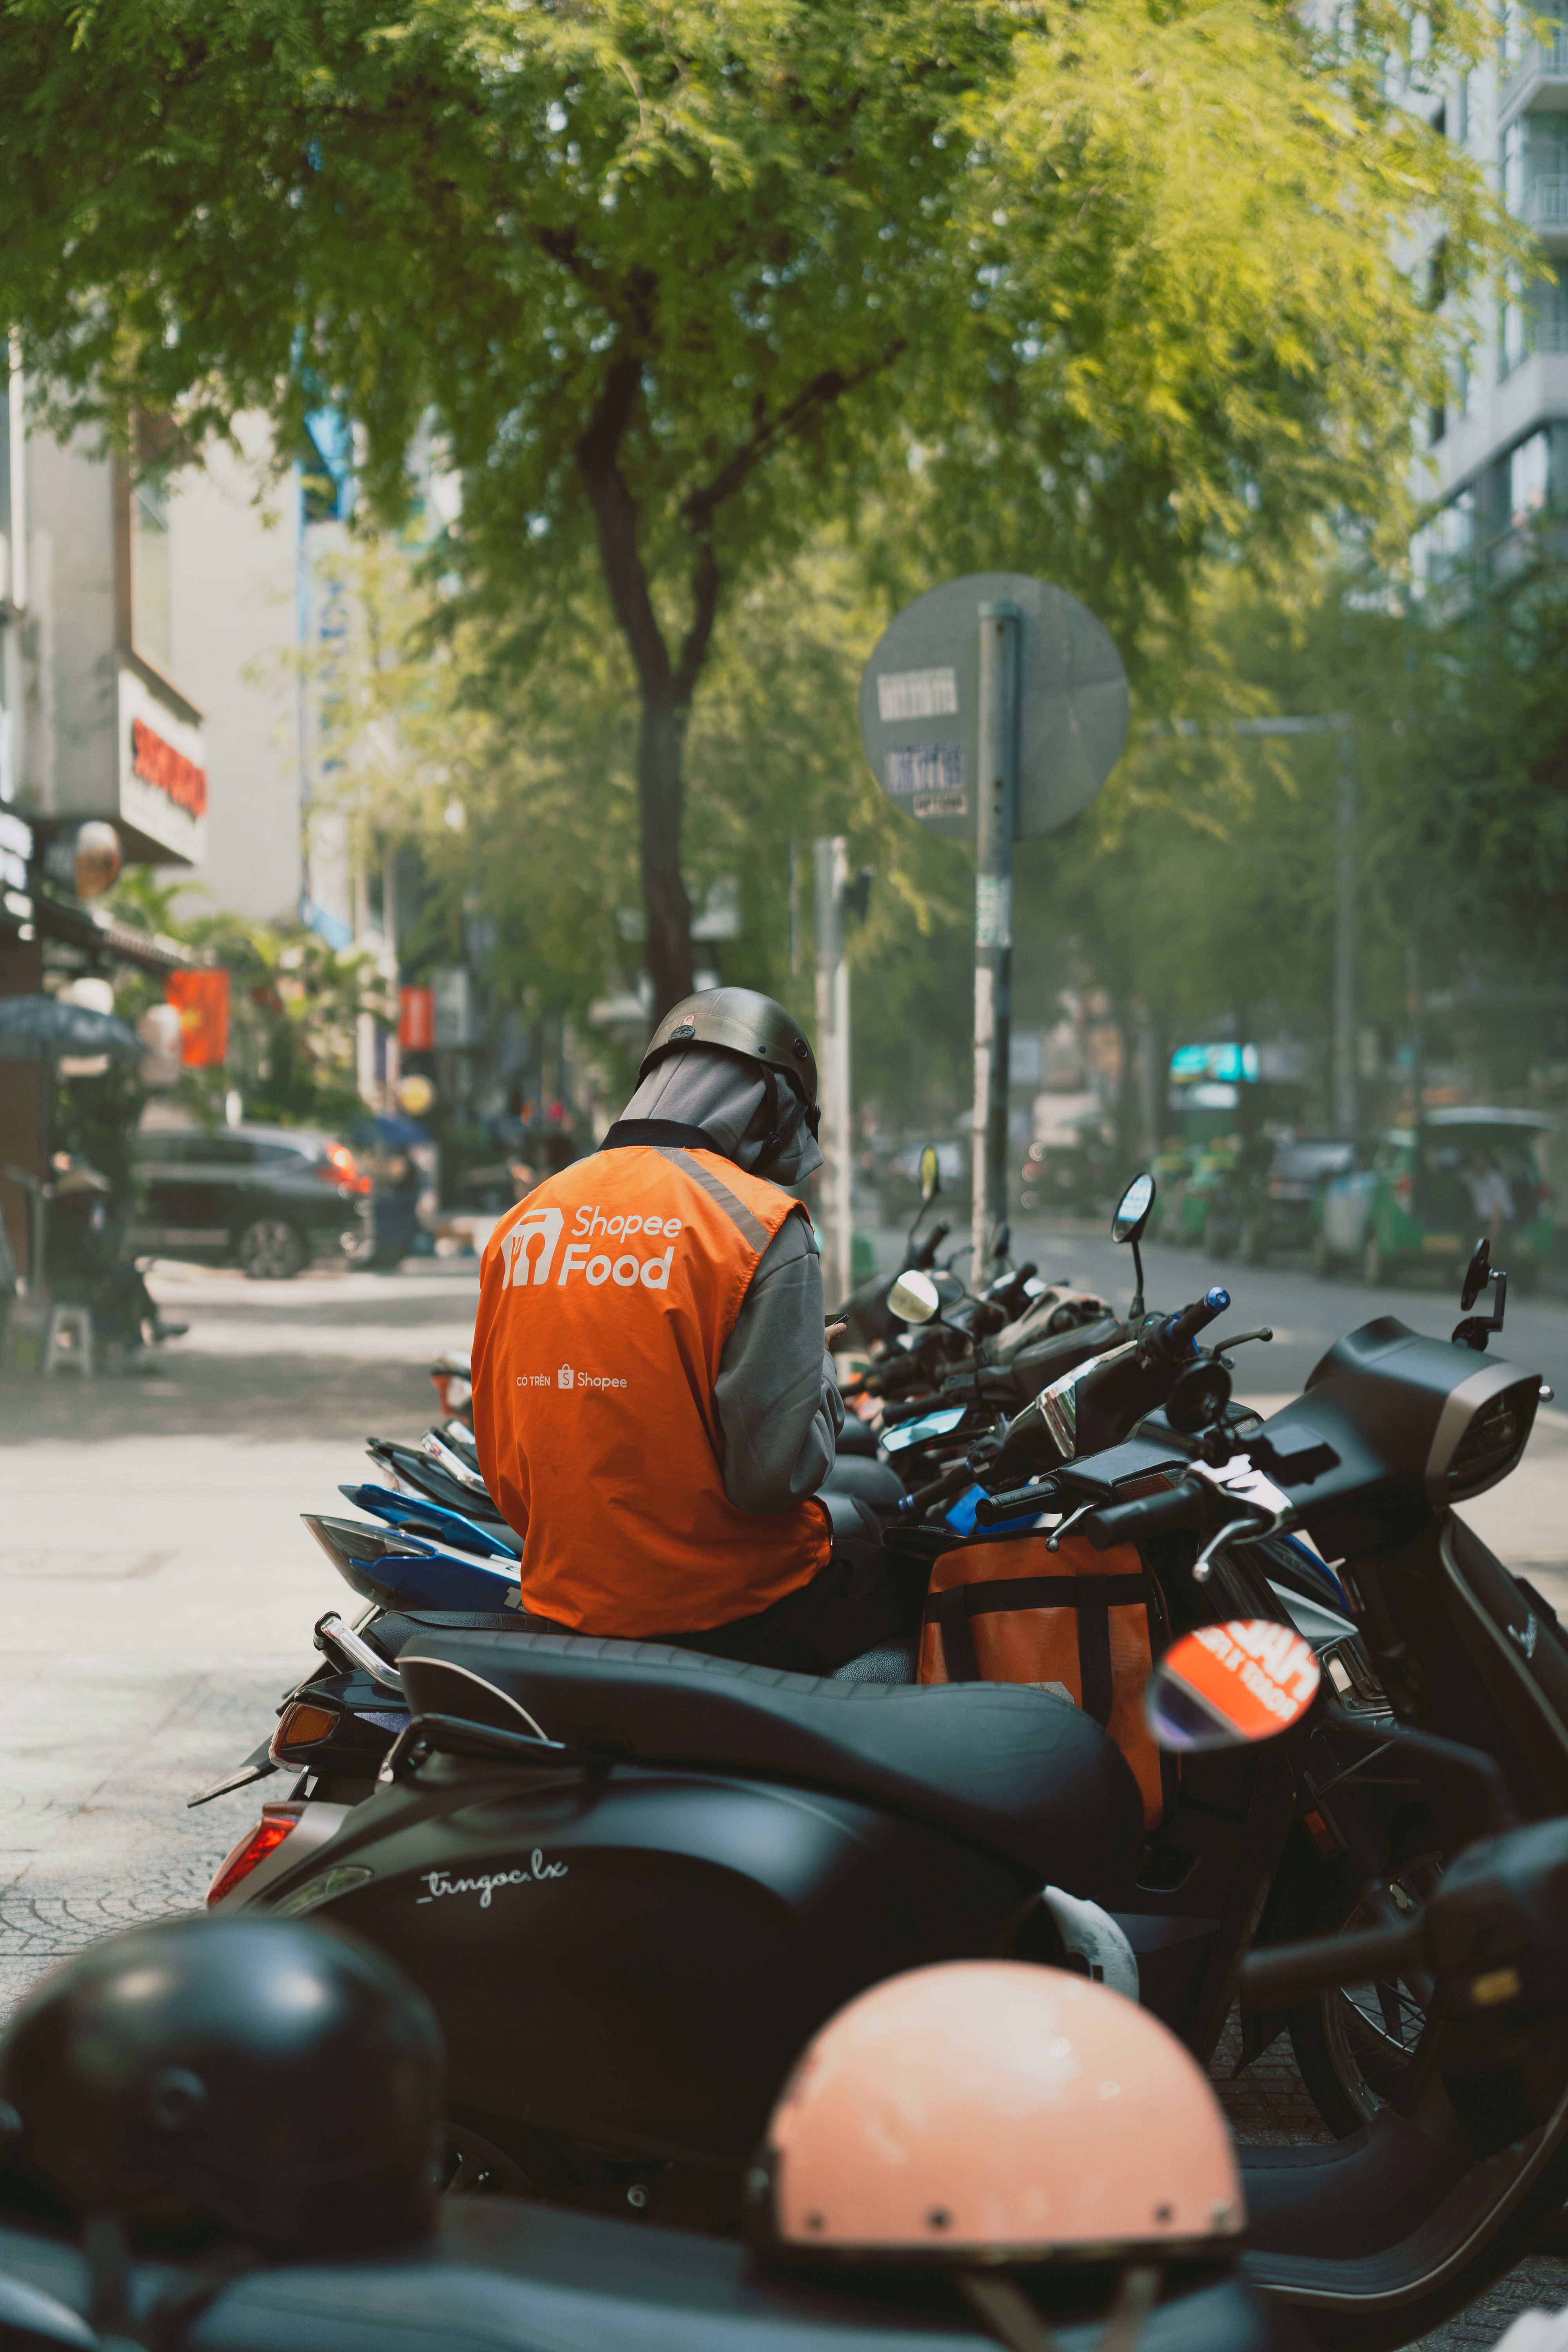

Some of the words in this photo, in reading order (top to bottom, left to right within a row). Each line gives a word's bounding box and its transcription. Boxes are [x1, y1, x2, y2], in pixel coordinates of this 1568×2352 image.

[571, 1206, 681, 1243] Shopee
[557, 1244, 675, 1290] Food
[516, 1374, 528, 1387] CÓ
[529, 1373, 550, 1386] TRÊN
[577, 1372, 627, 1391] Shopee
